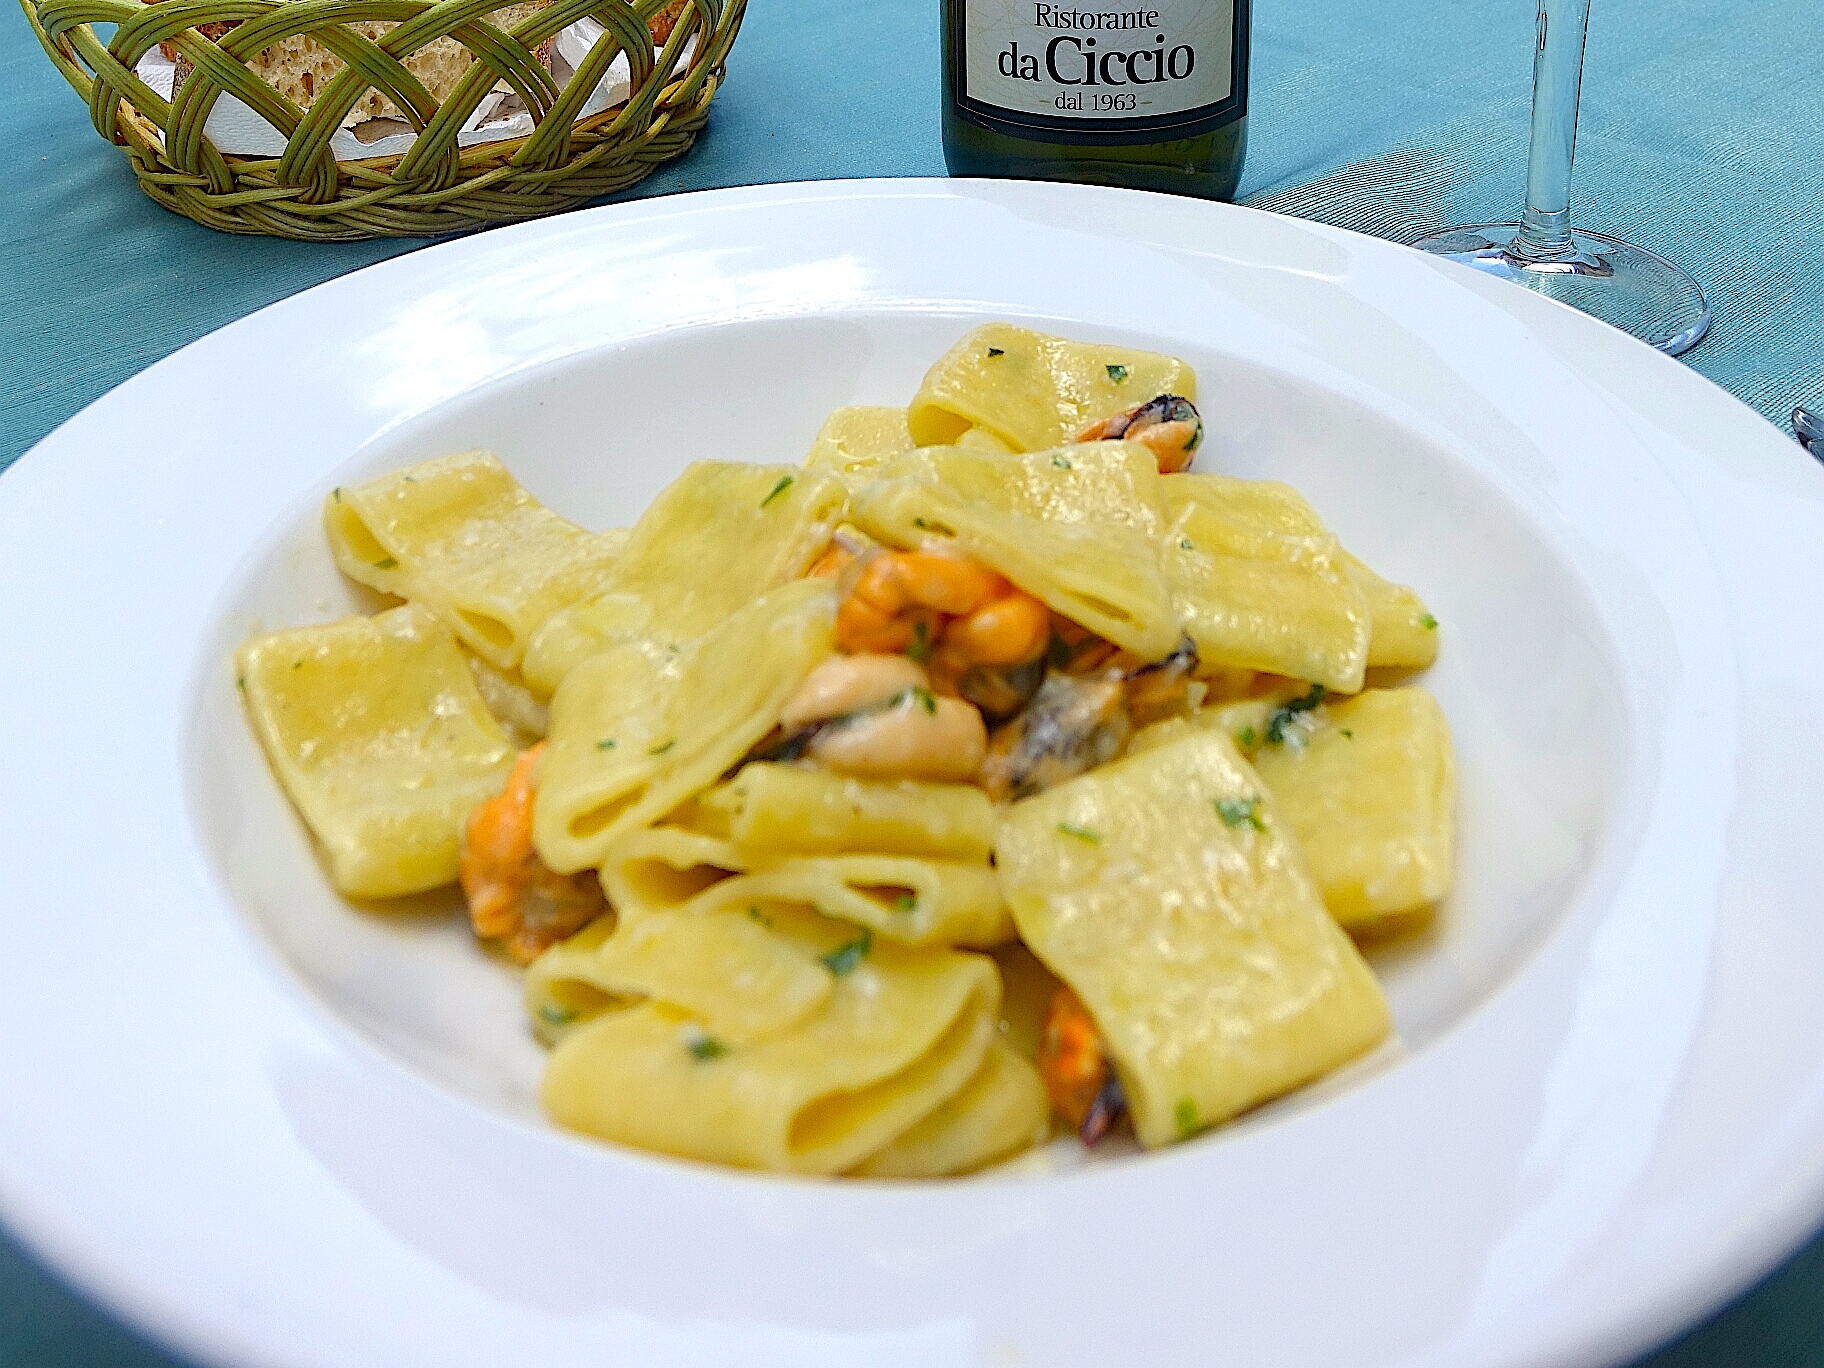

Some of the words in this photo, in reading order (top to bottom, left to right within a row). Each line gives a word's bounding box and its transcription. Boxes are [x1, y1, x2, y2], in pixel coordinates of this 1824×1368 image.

[1034, 2, 1159, 30] Ristorante
[998, 42, 1042, 82] da
[1046, 33, 1195, 86] Ciccio
[1054, 92, 1083, 110] dal
[1091, 93, 1137, 111] 1963
